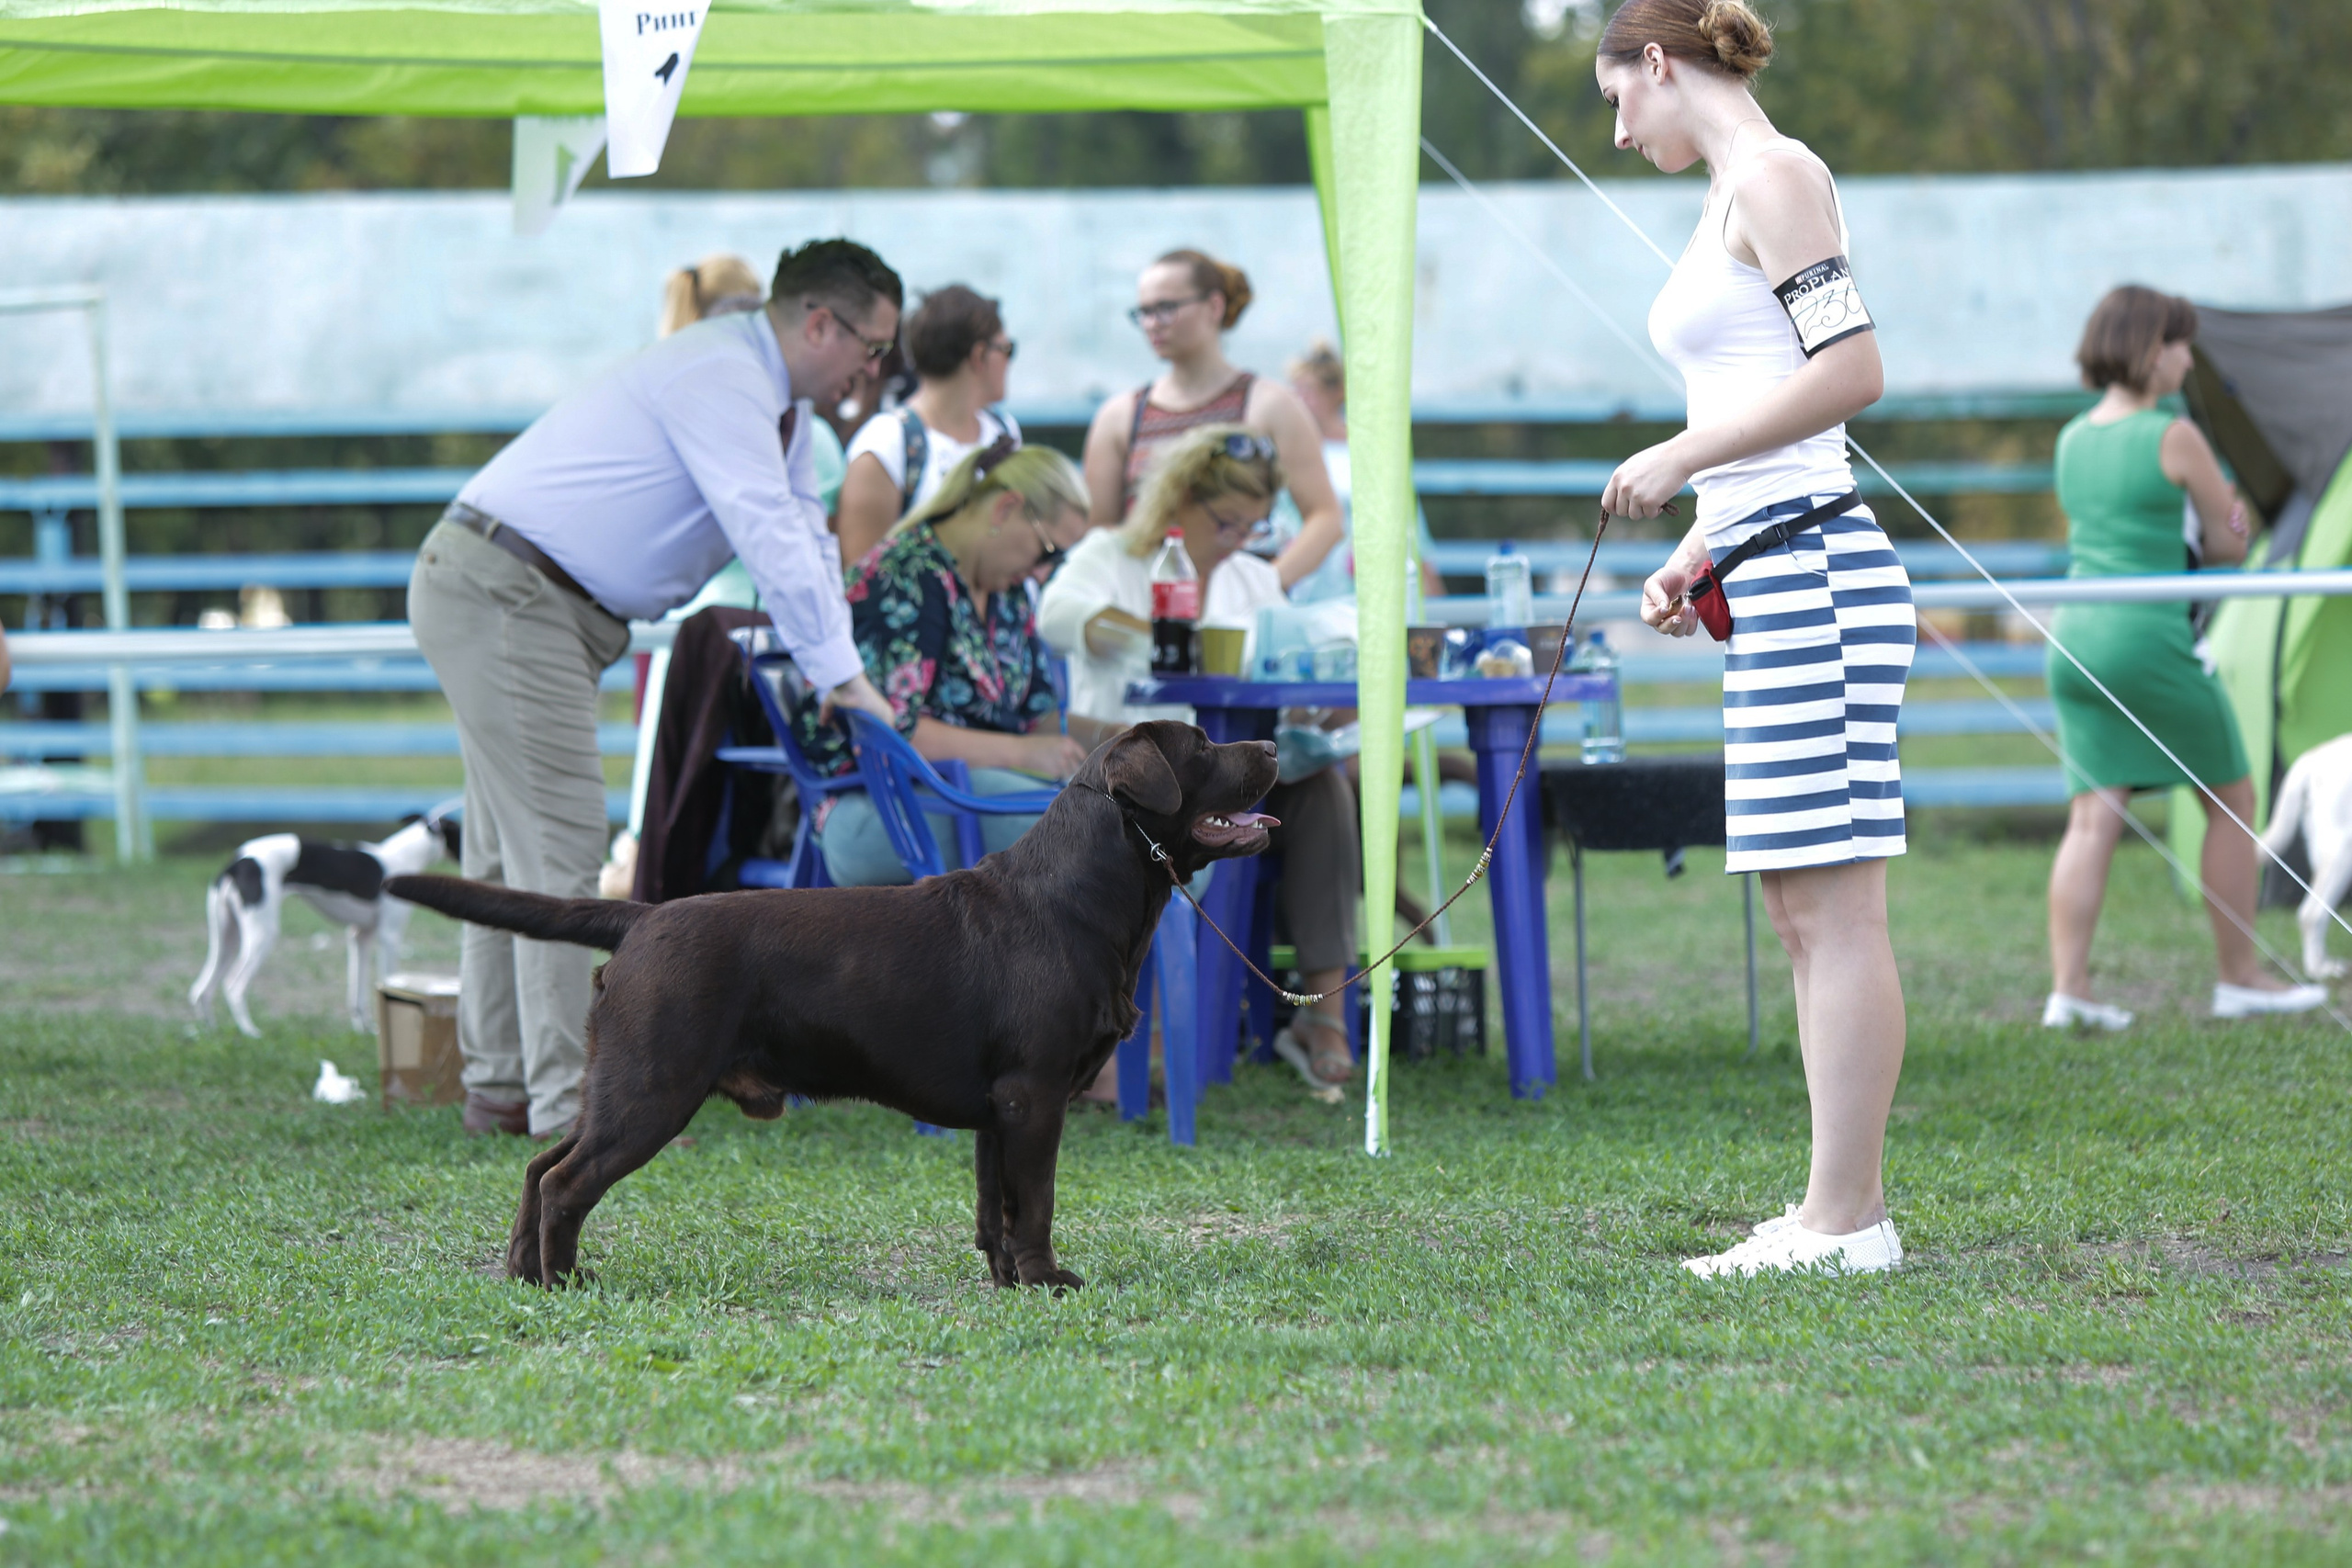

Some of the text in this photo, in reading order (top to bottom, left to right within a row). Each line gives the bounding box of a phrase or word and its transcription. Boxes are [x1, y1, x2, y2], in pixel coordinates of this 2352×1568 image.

[637, 10, 698, 35] Ринг
[1783, 266, 1850, 307] PRO PLAN
[1801, 263, 1827, 281] PURINA
[1800, 281, 1861, 339] 230
